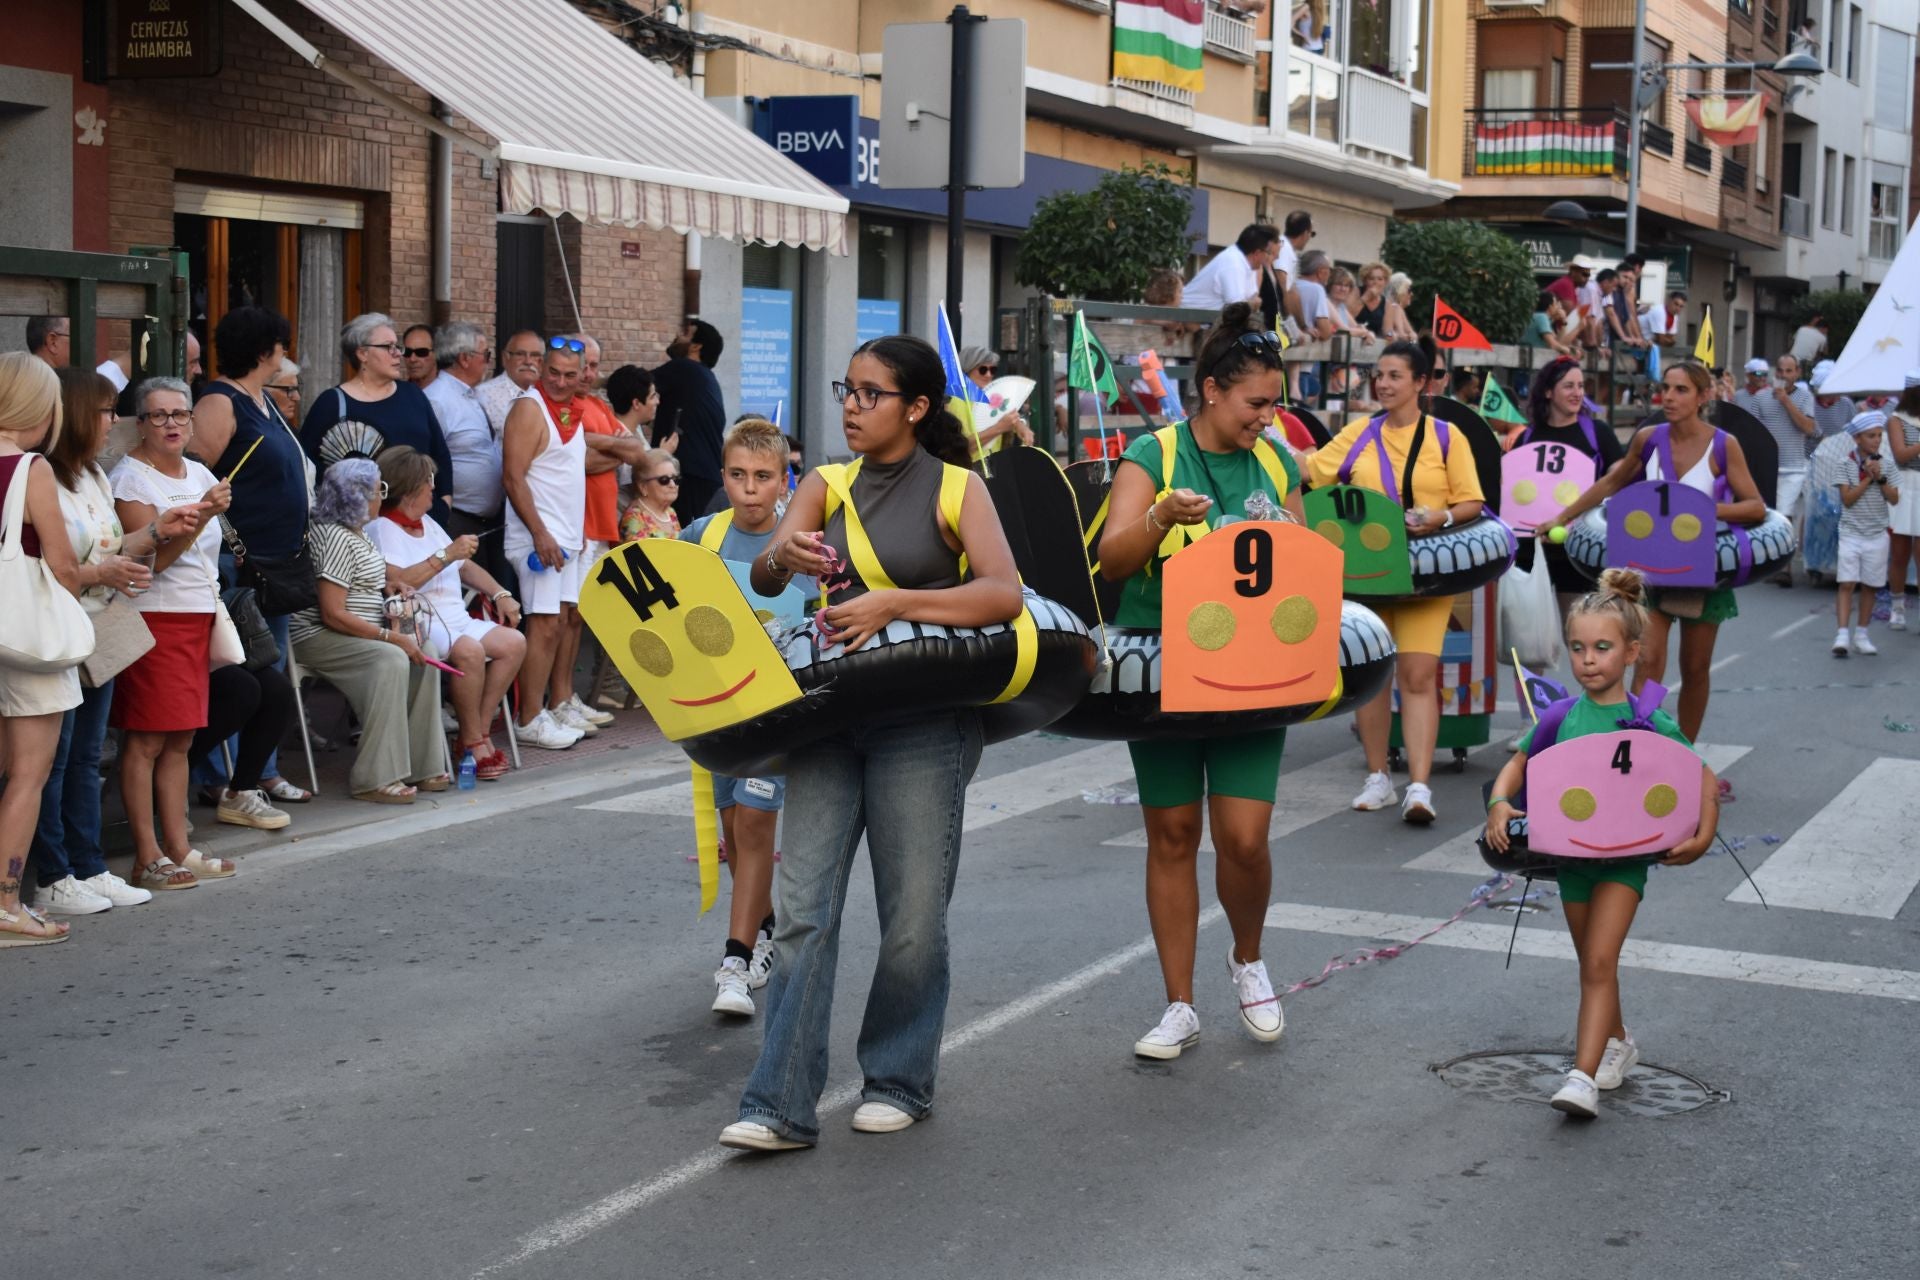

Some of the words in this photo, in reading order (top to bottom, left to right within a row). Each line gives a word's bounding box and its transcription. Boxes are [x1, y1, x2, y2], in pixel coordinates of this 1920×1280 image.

[131, 20, 189, 38] CERVEZAS
[127, 41, 192, 59] ALHAMBRA
[777, 129, 844, 152] BBVA
[858, 136, 880, 185] BB
[1527, 255, 1564, 267] URAL
[1438, 318, 1459, 338] 10
[1534, 445, 1566, 474] 13
[1328, 487, 1366, 524] 10
[1654, 484, 1670, 516] 1
[1234, 528, 1272, 598] 9
[596, 543, 680, 623] 14
[1611, 740, 1632, 774] 4
